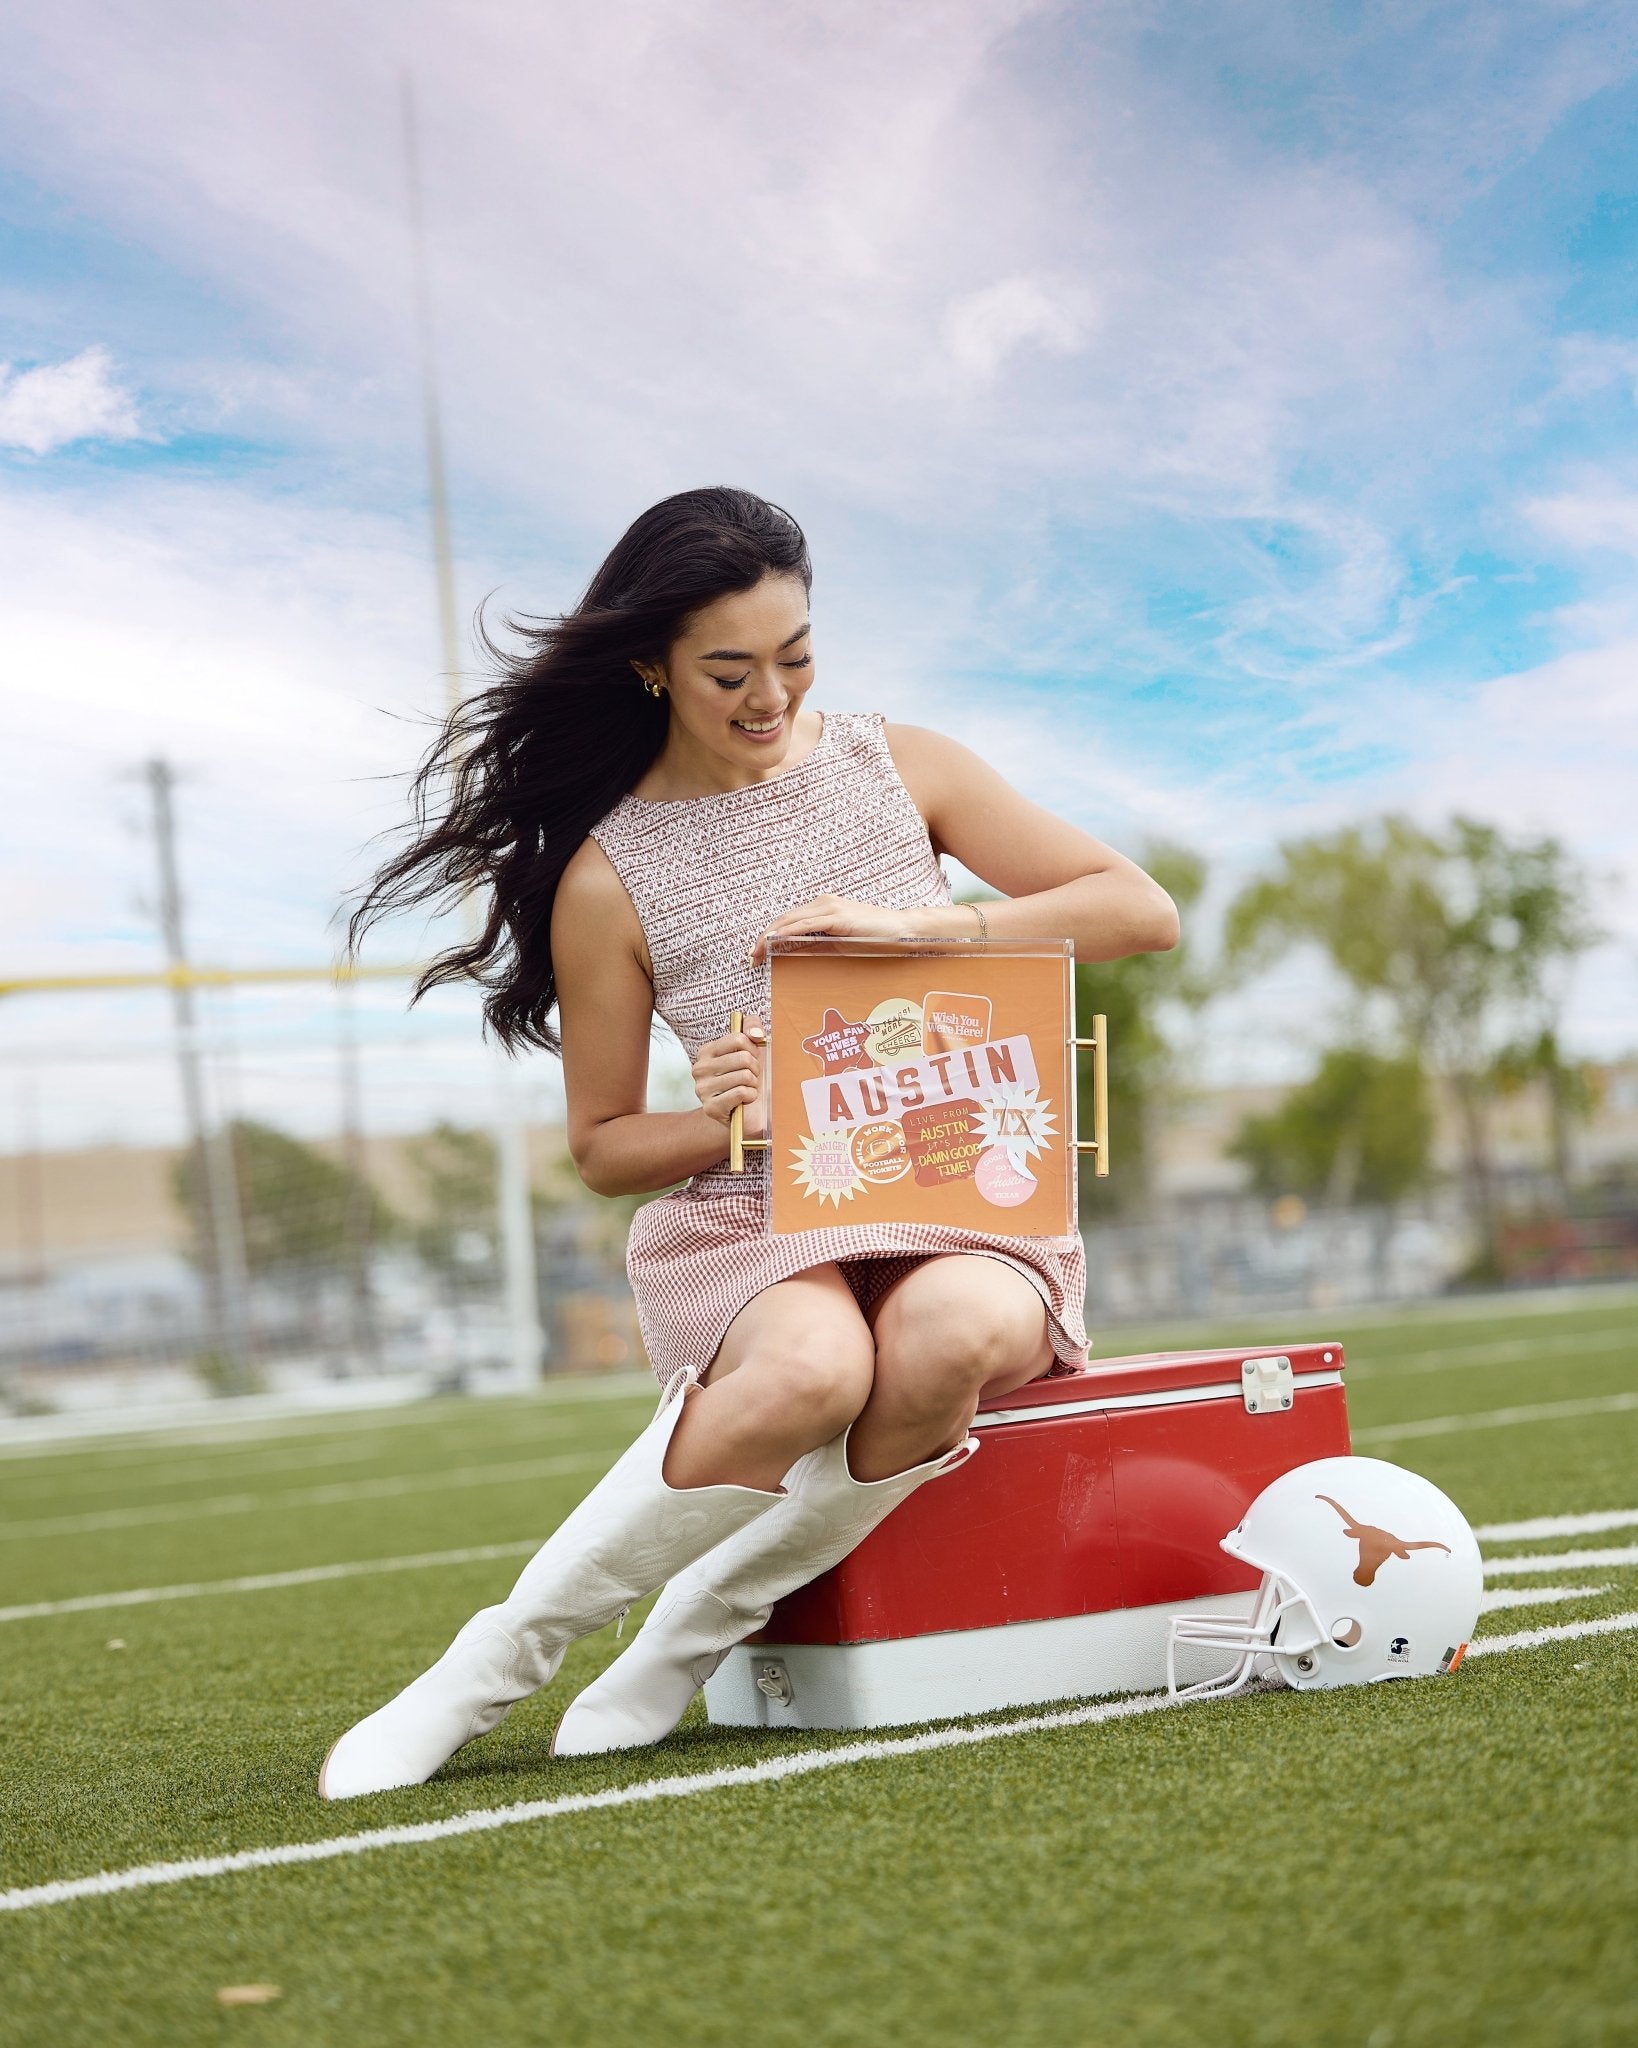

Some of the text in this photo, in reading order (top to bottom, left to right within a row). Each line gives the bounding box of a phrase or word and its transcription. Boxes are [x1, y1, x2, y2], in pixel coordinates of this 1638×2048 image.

[932, 1012, 980, 1027] Wish You
[881, 1020, 903, 1037] MORE
[927, 1021, 984, 1037] Were Here!
[813, 1031, 841, 1048] YOUR
[824, 1036, 859, 1053] LIVES
[882, 1032, 917, 1049] CHEERS
[826, 1044, 861, 1062] IN ATX
[829, 1044, 1017, 1122] AUSTIN
[910, 1107, 969, 1126] LIVE FROM
[993, 1108, 1037, 1136] TX
[920, 1120, 970, 1141] AUSTIN
[833, 1141, 848, 1151] GET
[856, 1125, 907, 1165] WILL WORK FOR
[927, 1136, 965, 1151] IT'S A
[863, 1157, 905, 1169] FOOTBALL
[918, 1143, 982, 1167] DAMN GOOD
[809, 1165, 858, 1176] YEAH
[868, 1164, 902, 1175] TICKETS
[936, 1160, 972, 1177] TIME!
[986, 1172, 1025, 1190] Austin
